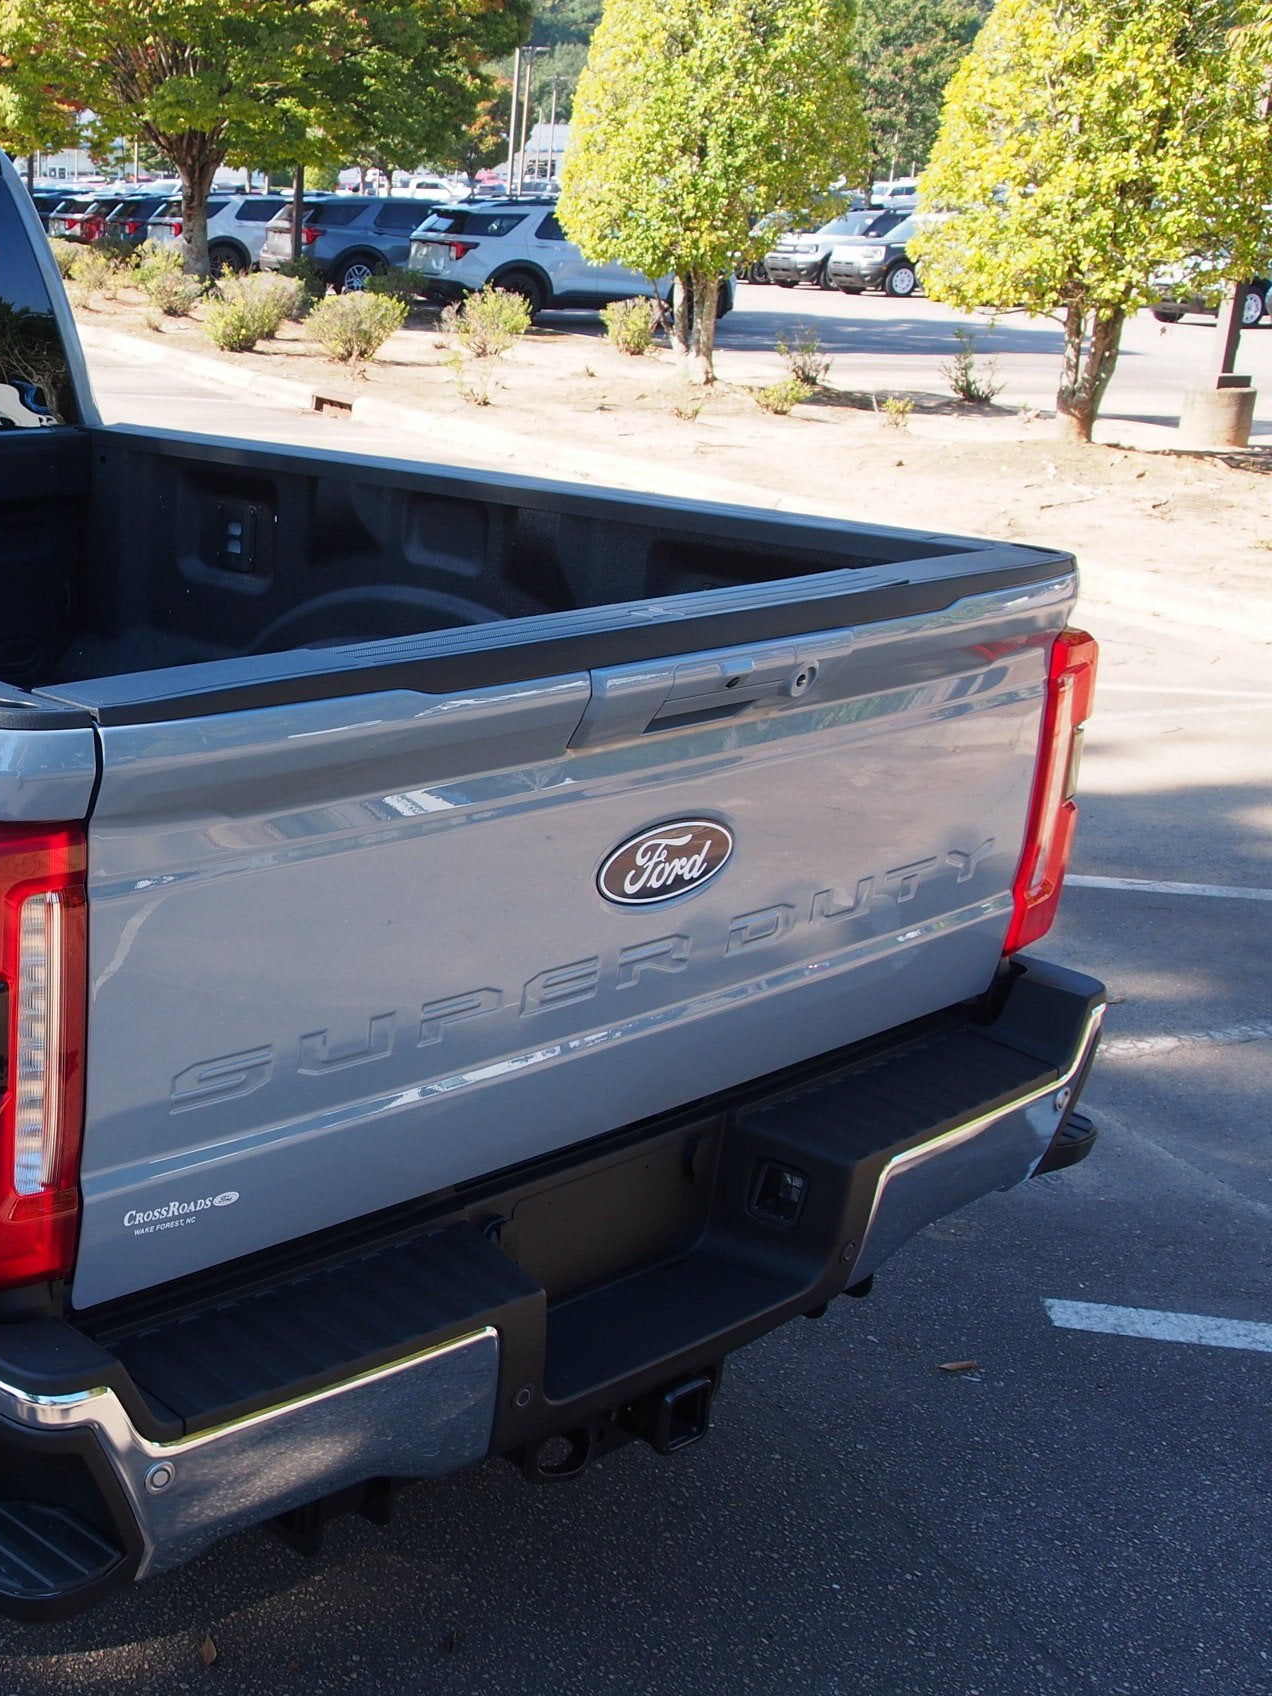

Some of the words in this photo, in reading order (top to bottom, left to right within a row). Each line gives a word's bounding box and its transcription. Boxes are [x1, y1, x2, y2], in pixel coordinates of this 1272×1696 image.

[623, 833, 712, 895] Ford
[169, 933, 691, 1115] SUPER
[725, 837, 995, 957] DUTY
[134, 1225, 155, 1236] WAKE
[155, 1219, 185, 1232] FOREST,
[185, 1216, 197, 1225] NC
